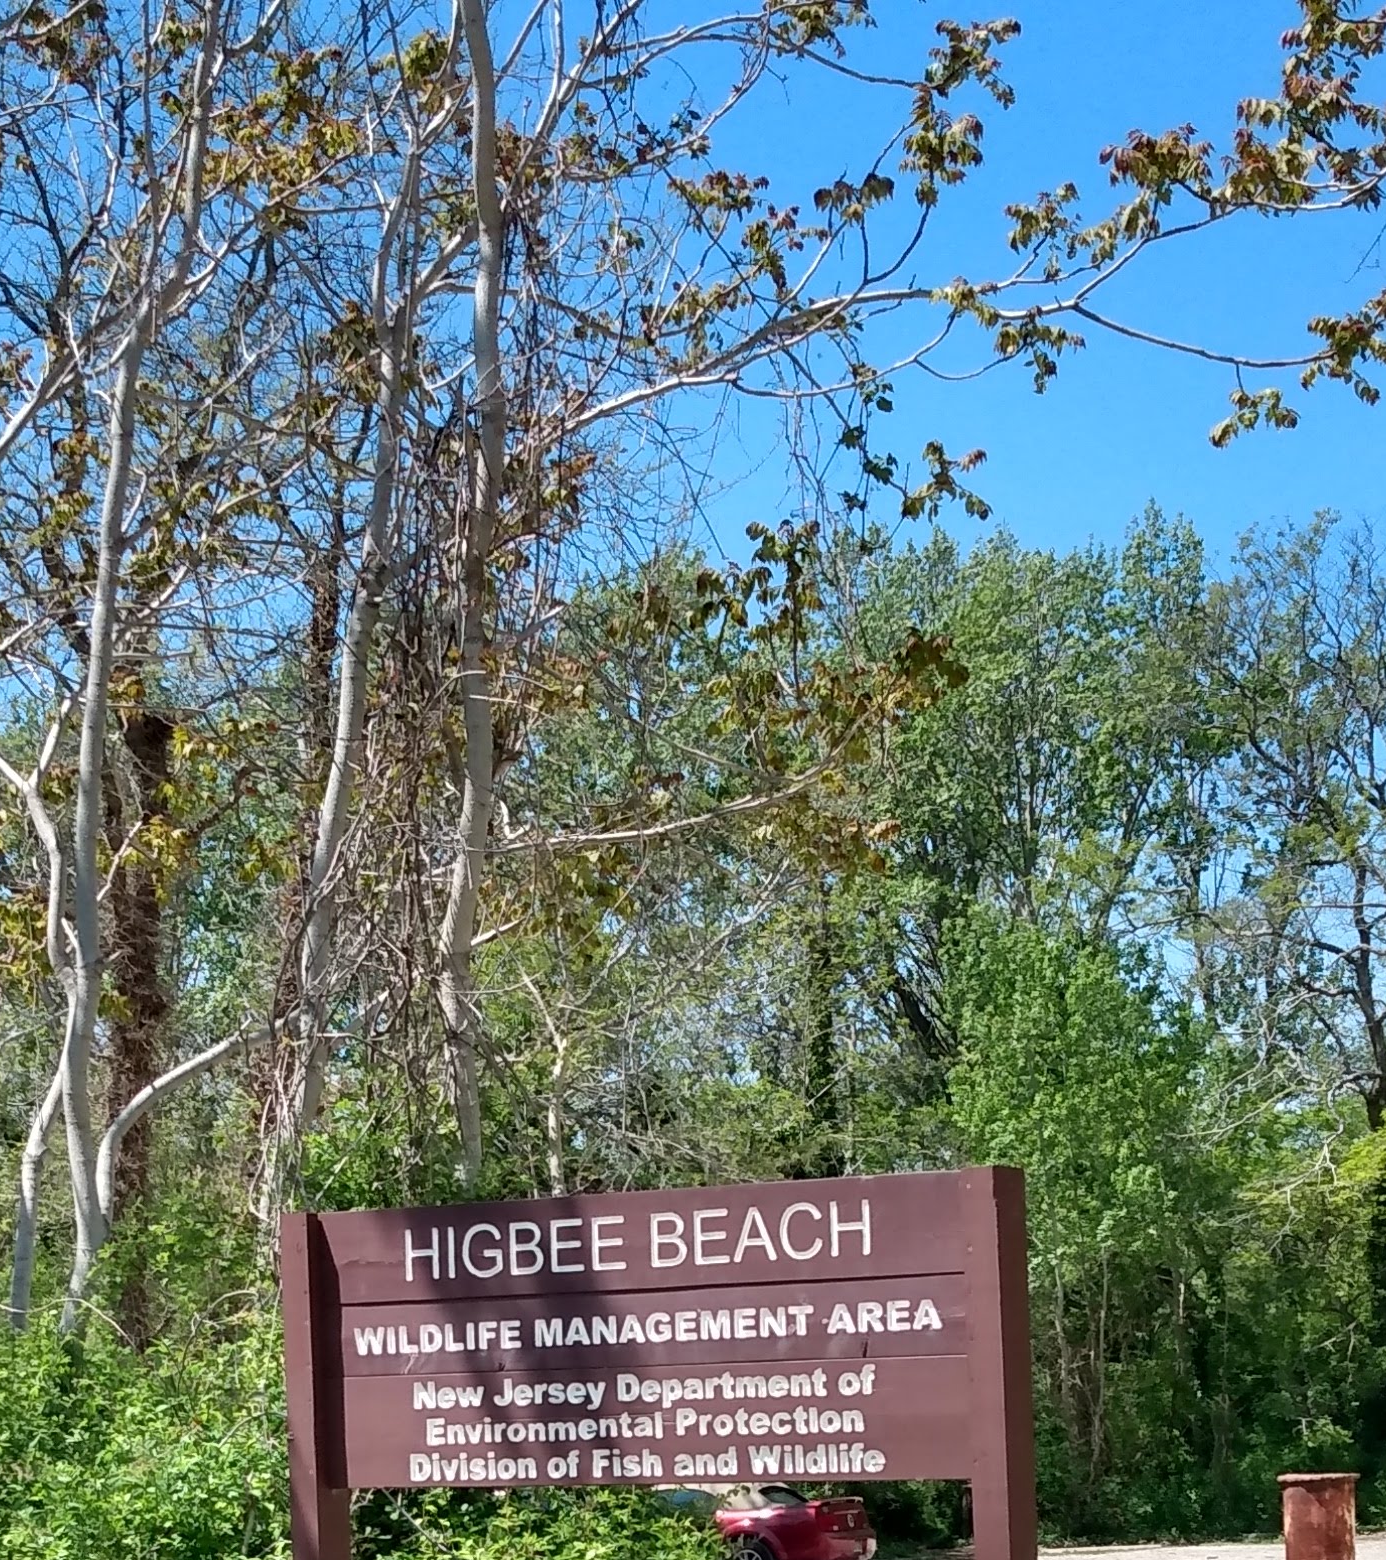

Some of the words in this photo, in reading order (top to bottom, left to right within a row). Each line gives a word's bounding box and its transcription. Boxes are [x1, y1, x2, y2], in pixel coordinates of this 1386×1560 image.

[404, 1215, 627, 1281] HIGBEE
[650, 1199, 871, 1268] BEACH
[354, 1320, 522, 1356] WILDLIFE
[534, 1305, 814, 1348] MANAGEMENT
[827, 1299, 943, 1334] AREA
[413, 1380, 484, 1410] New
[493, 1378, 606, 1410] Jersey
[617, 1367, 827, 1408] Department
[838, 1364, 876, 1396] of
[426, 1411, 664, 1446] Environmental
[676, 1406, 865, 1436] Protection
[410, 1452, 537, 1482] Division
[547, 1449, 580, 1479] of
[592, 1448, 663, 1478] Fish
[674, 1446, 738, 1476] and
[748, 1443, 886, 1475] Wildlife
